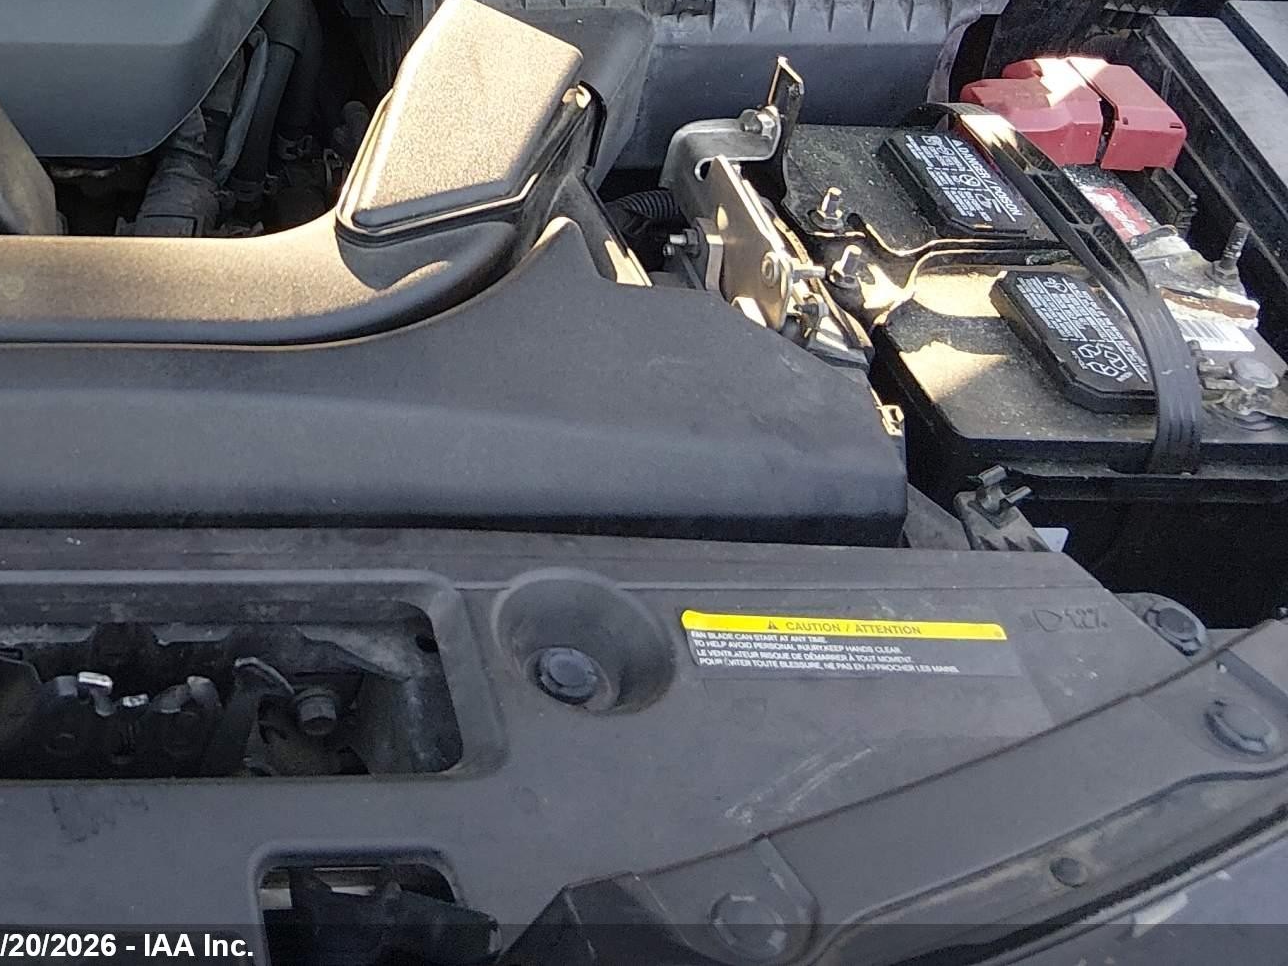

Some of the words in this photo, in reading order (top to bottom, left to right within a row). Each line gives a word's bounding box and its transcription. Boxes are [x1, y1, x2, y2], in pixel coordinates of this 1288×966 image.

[958, 147, 992, 179] DANGER
[990, 185, 1023, 216] POISON
[707, 631, 734, 639] BLADE
[786, 622, 841, 632] CAUTION
[855, 624, 922, 635] ATTENTION
